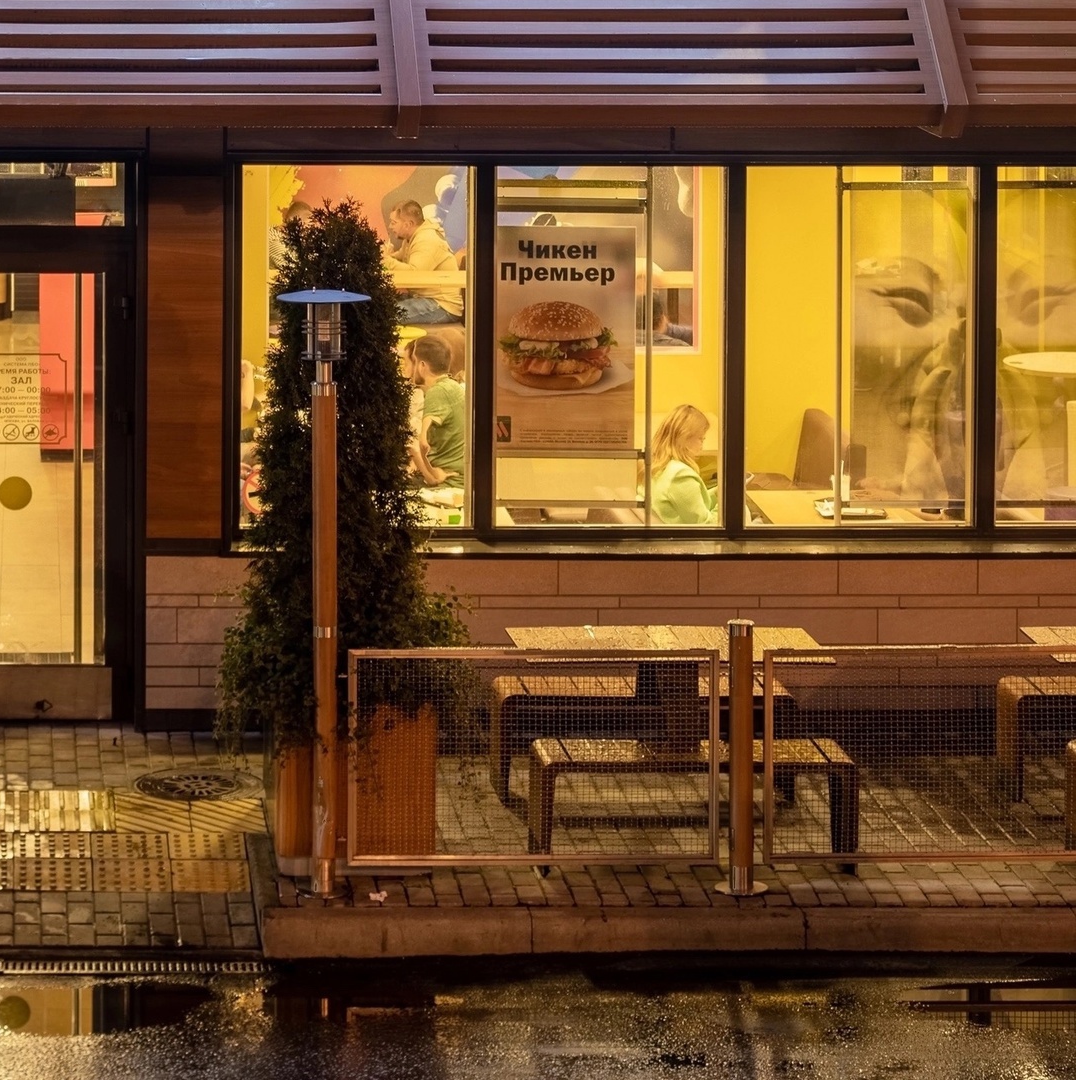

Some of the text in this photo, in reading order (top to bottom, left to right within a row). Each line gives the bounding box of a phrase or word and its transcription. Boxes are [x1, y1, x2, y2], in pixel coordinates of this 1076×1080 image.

[518, 239, 597, 260] Чикен
[500, 262, 615, 286] Премьер
[10, 376, 32, 385] ЗАЛ
[26, 386, 51, 394] 00:00
